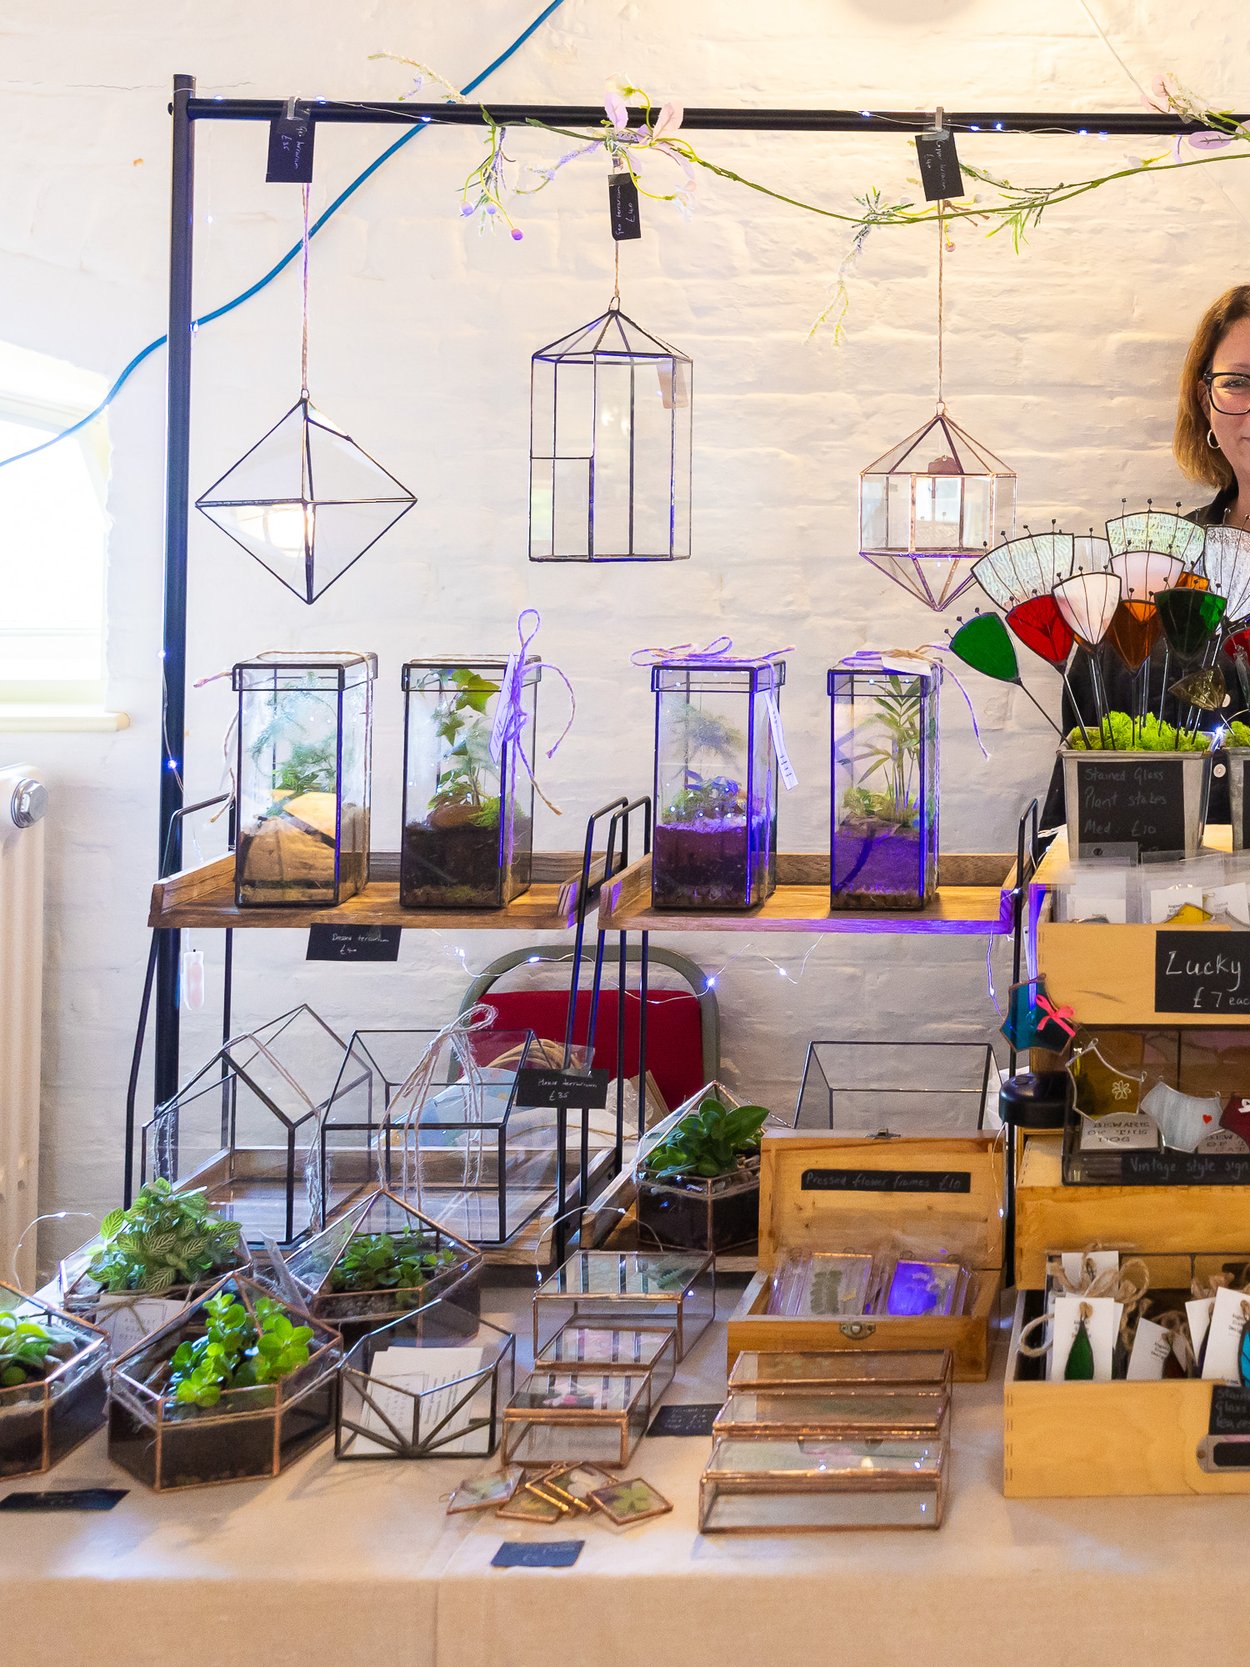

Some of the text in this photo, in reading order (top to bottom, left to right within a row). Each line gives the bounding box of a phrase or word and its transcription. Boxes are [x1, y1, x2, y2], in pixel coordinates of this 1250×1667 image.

[1085, 766, 1164, 785] Stained Glass
[1084, 786, 1119, 808] Plant
[1084, 819, 1157, 837] Med £10
[1165, 950, 1242, 992] Lucky
[548, 1090, 570, 1101] £35
[1093, 1121, 1150, 1129] BEWARE
[1130, 1157, 1176, 1180] Vintage
[1186, 1158, 1216, 1179] style
[806, 1171, 961, 1191] Pressed flower frames £10
